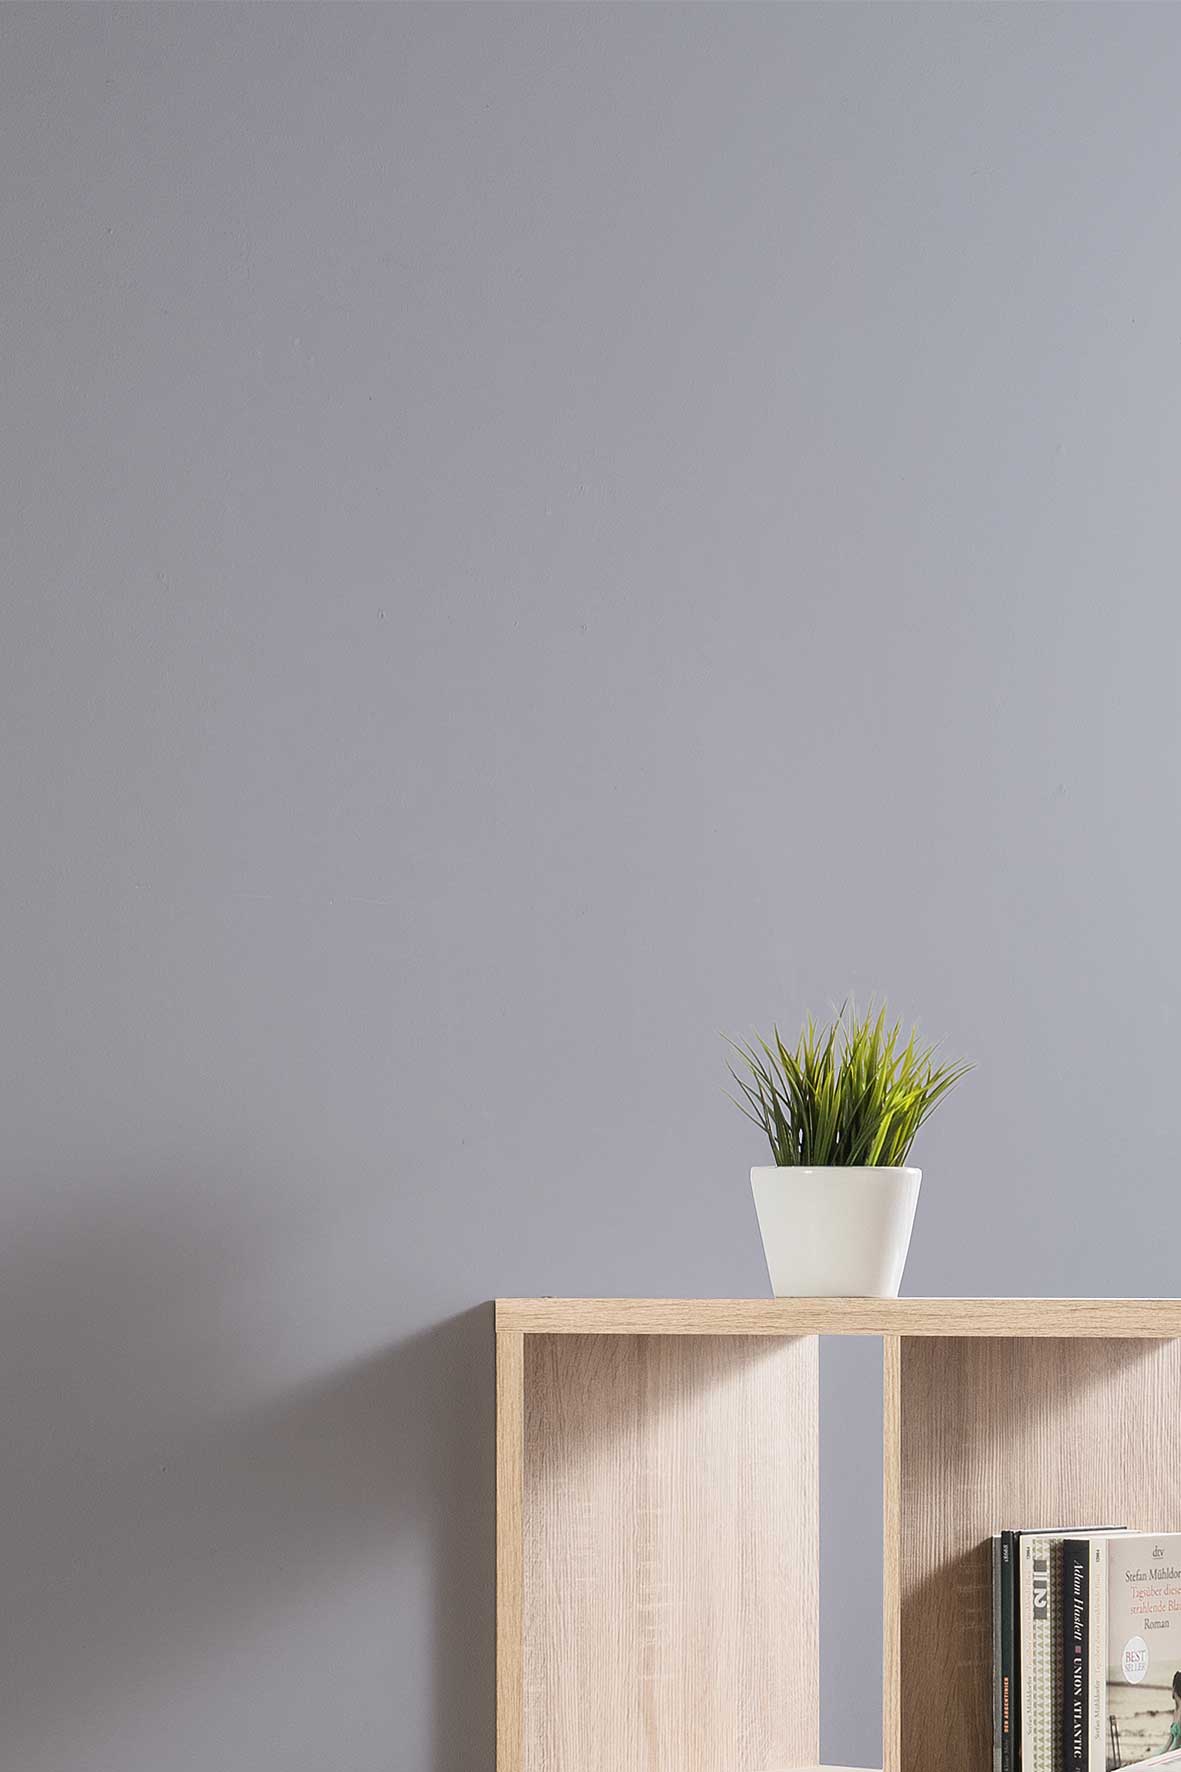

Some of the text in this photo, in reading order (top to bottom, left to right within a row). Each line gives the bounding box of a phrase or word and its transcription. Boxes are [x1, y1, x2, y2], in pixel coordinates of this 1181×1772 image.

[1125, 1569, 1147, 1582] Stefan
[1073, 1560, 1084, 1641] Adam Haslett
[1144, 1618, 1170, 1630] Roman
[1126, 1650, 1146, 1662] BEST
[1073, 1657, 1082, 1759] UNION ATLANTIC
